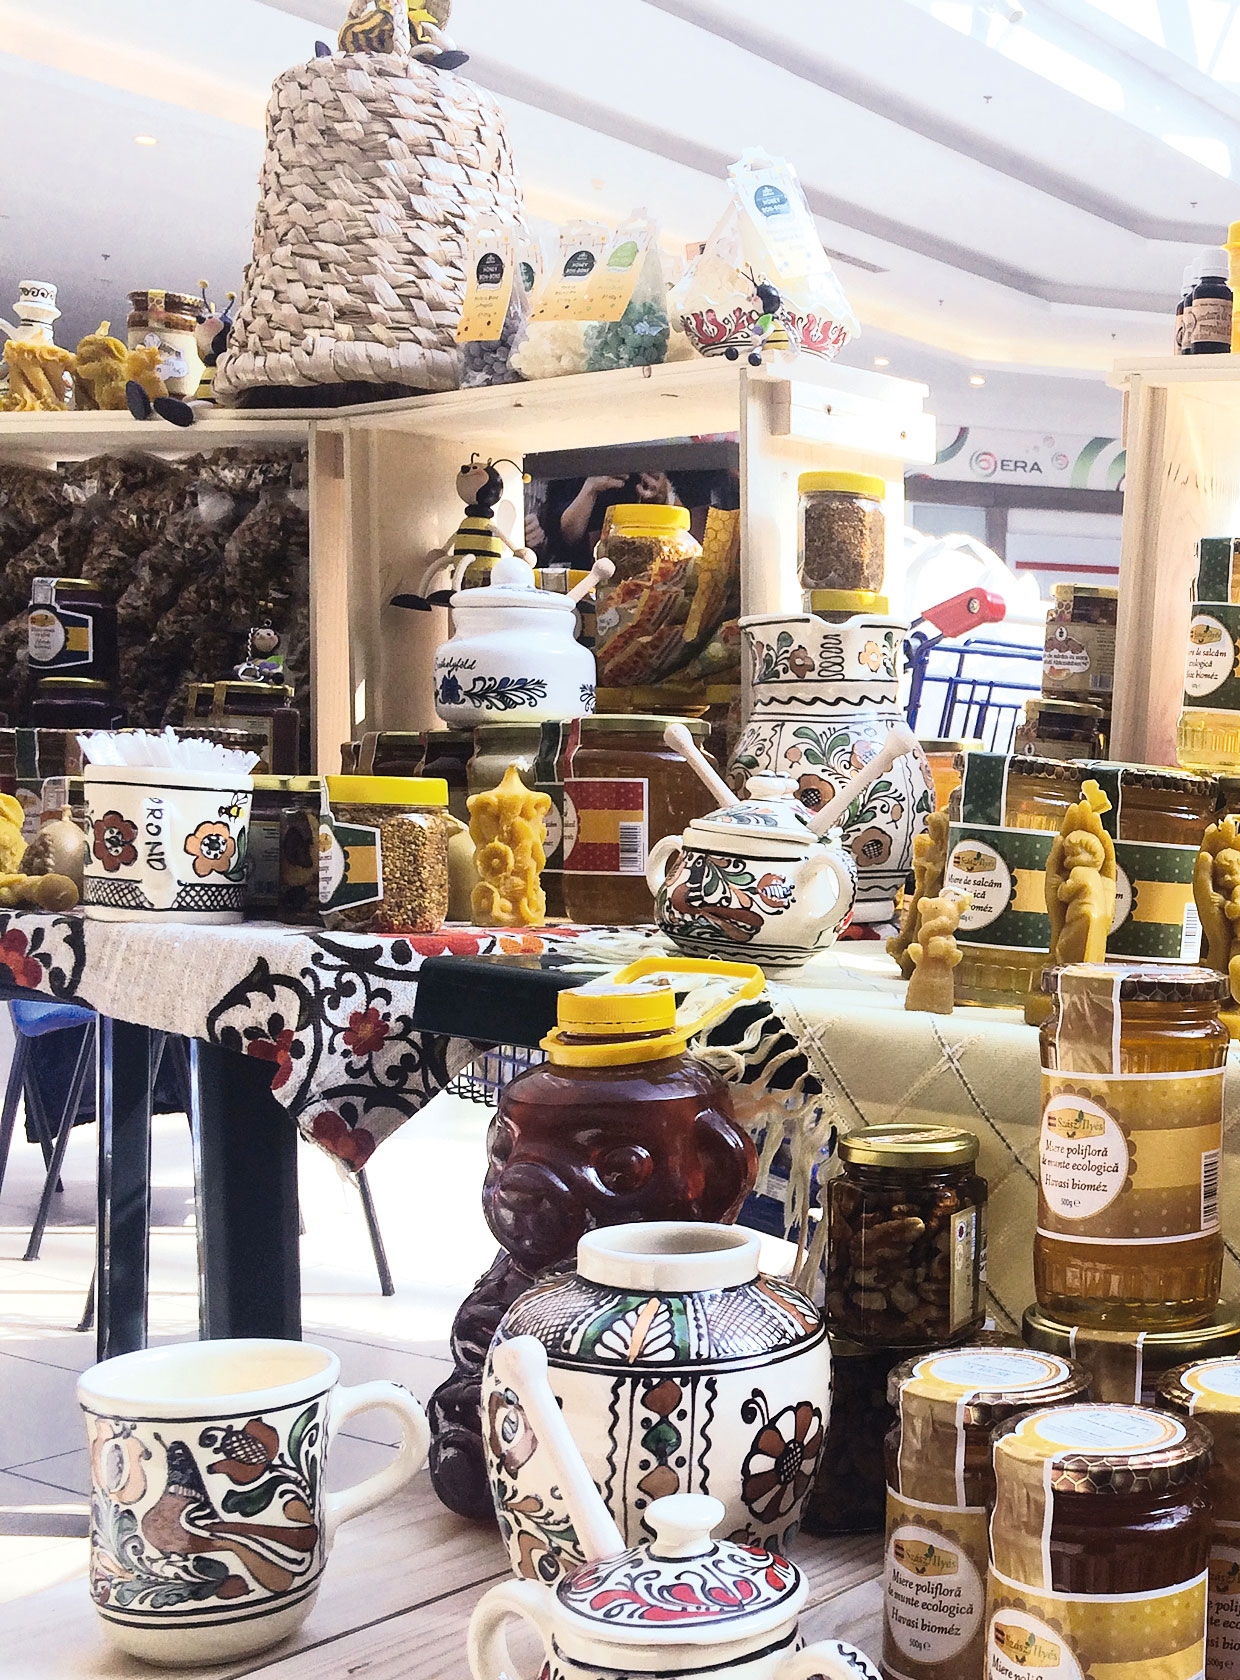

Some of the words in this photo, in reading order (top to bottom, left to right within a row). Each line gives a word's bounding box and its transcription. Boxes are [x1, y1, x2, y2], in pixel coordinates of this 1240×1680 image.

[1001, 459, 1043, 474] ERA
[970, 904, 993, 913] oméz
[1066, 1143, 1109, 1159] polifloră
[1071, 1160, 1120, 1176] ecologică
[1071, 1178, 1109, 1193] bioméz
[892, 1568, 914, 1589] Miere
[915, 1580, 963, 1599] polifloră
[894, 1590, 920, 1608] munte
[921, 1600, 975, 1618] ecologică
[891, 1606, 919, 1629] Havasi
[920, 1618, 962, 1636] bioméz
[992, 1653, 1013, 1679] Miere
